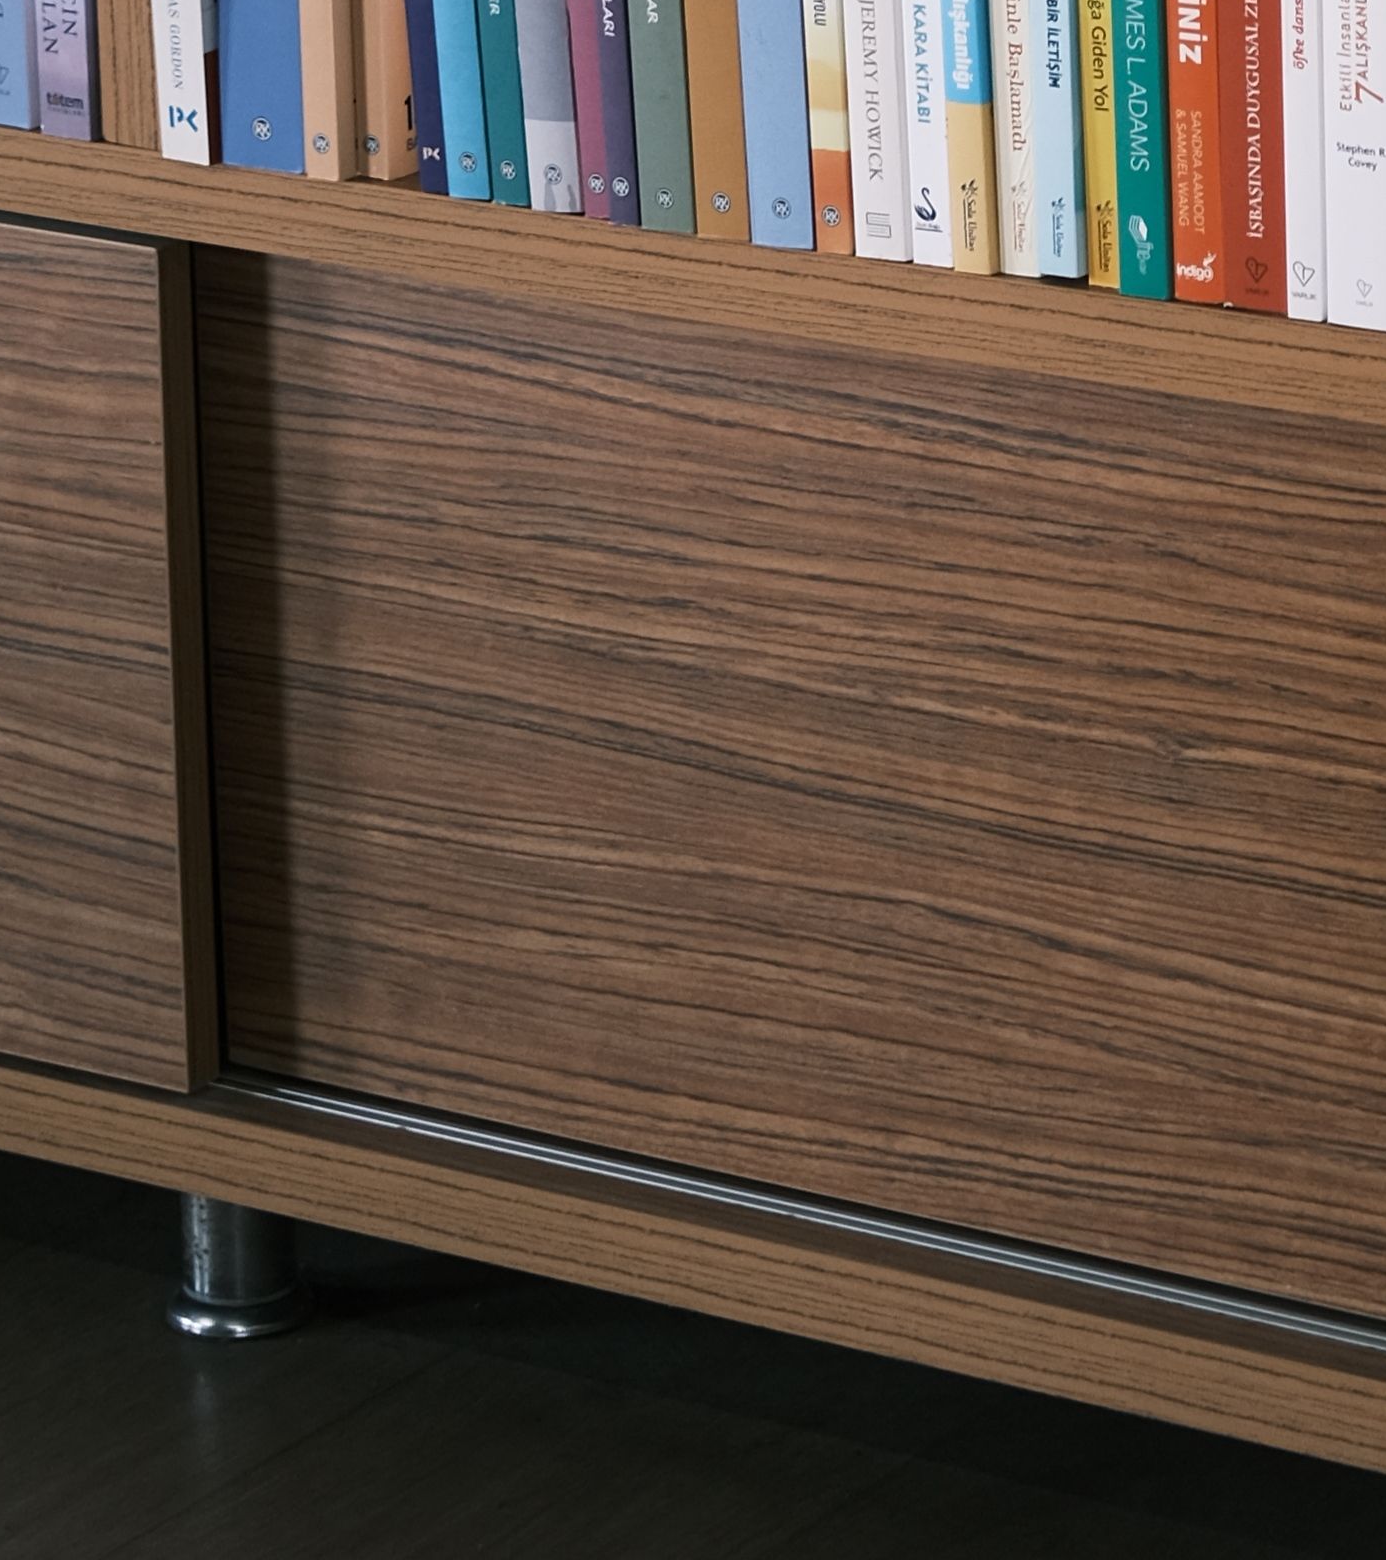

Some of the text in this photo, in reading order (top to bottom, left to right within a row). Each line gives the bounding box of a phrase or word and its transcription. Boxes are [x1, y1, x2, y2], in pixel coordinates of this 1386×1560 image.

[1124, 58, 1149, 76] L.
[1241, 23, 1264, 128] DUYGUSAL
[861, 90, 884, 182] HOWICK
[1125, 80, 1151, 172] ADAMS
